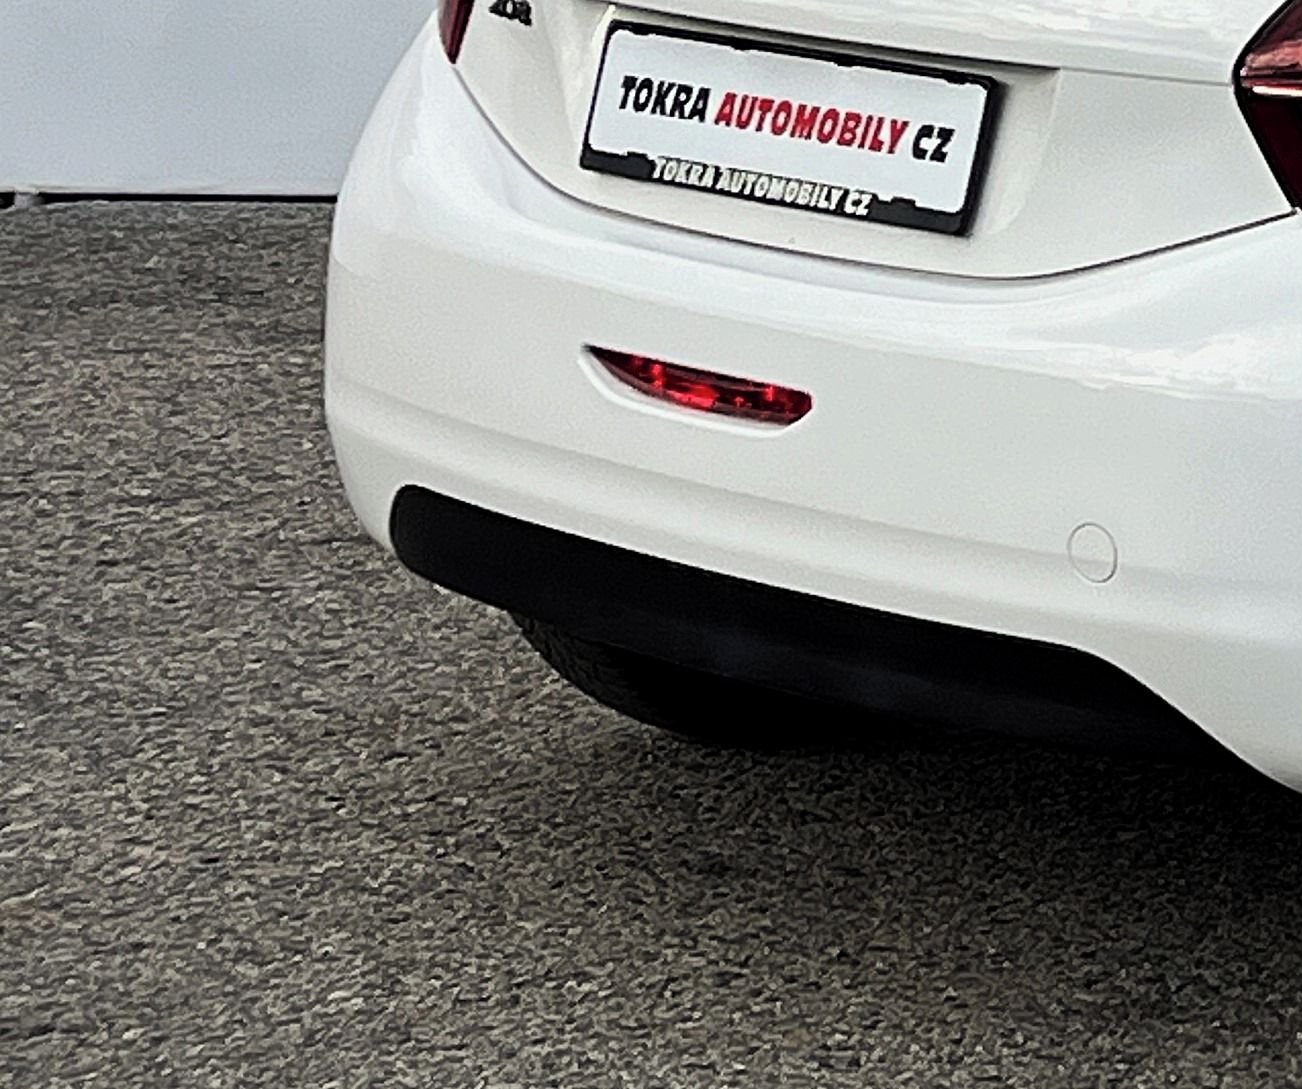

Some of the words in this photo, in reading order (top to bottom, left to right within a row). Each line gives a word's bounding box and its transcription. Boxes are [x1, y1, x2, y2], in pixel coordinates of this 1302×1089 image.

[619, 75, 711, 123] TOKRA
[714, 91, 910, 154] AUTOMOBILY
[912, 124, 955, 163] CZ
[652, 157, 715, 189] TOKRA
[716, 167, 844, 211] AUTOMOBILY
[844, 190, 873, 216] CZ
